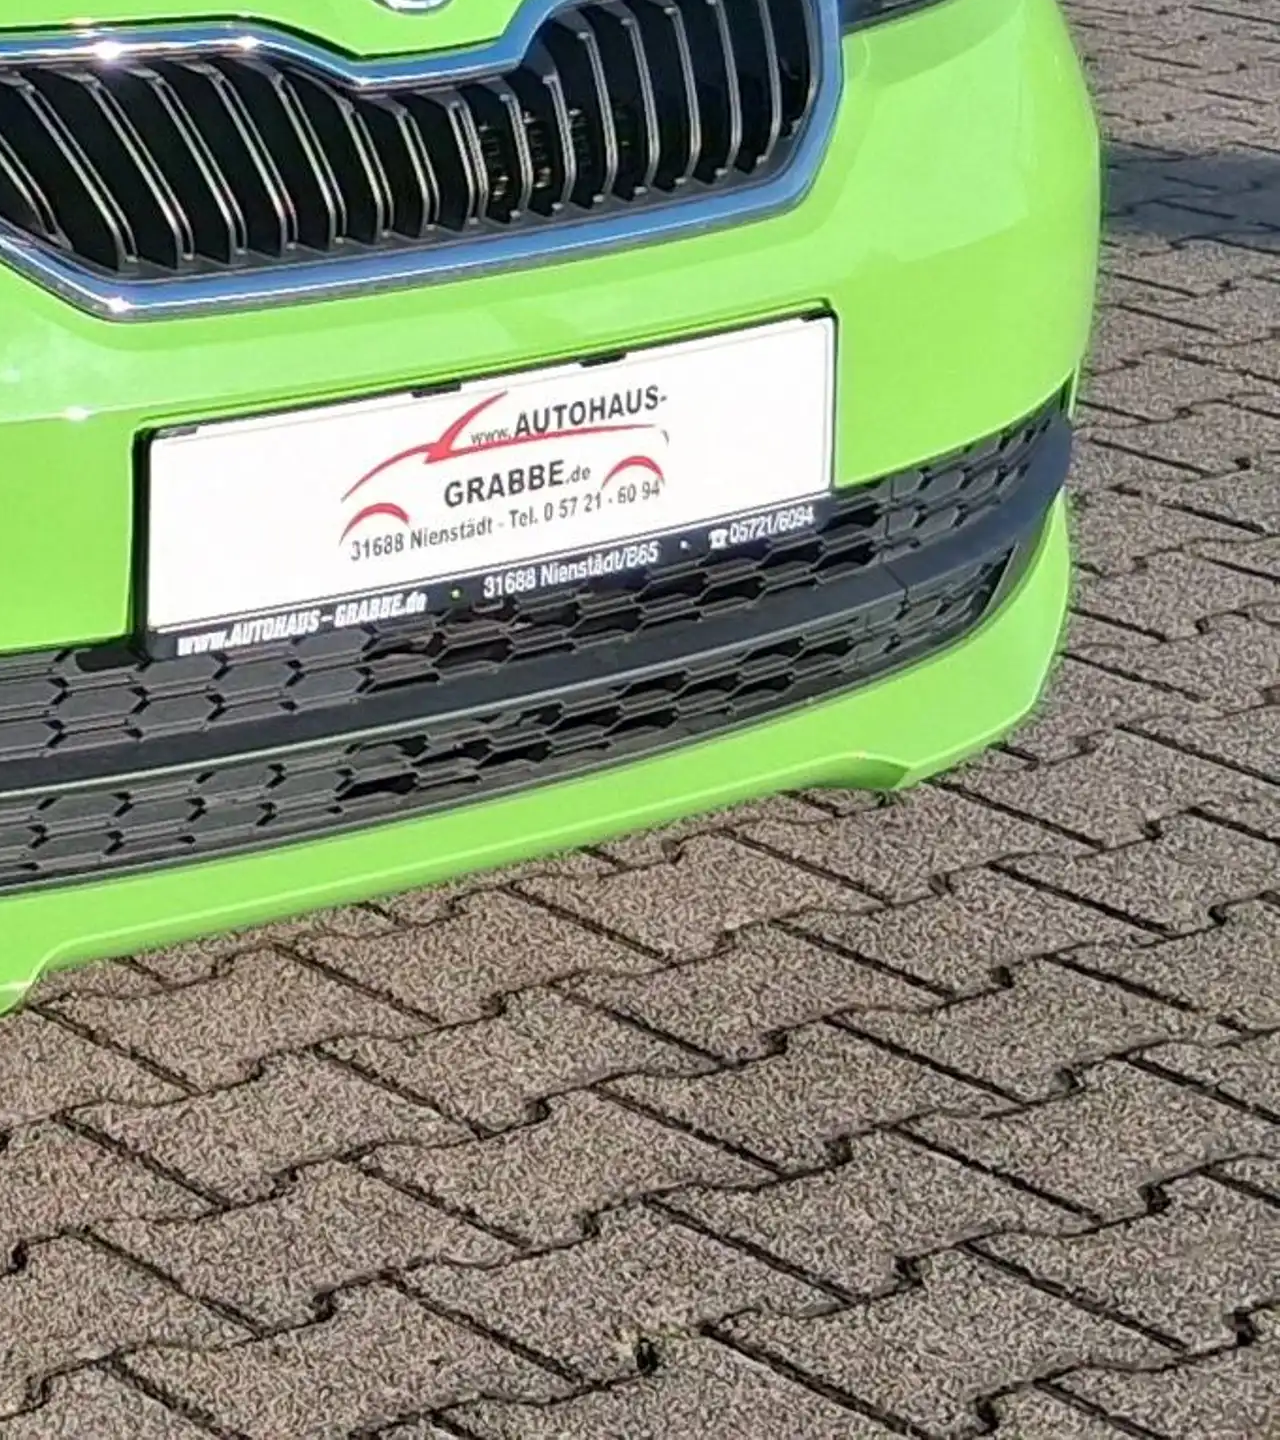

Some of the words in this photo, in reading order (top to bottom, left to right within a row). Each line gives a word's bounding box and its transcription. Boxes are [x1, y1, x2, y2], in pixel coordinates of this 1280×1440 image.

[350, 532, 405, 562] 31688
[410, 516, 493, 550] Nienstädt
[509, 509, 539, 530] Tel.
[558, 497, 578, 519] 57
[584, 492, 602, 513] 21
[641, 479, 661, 499] 94
[444, 460, 592, 508] GRABBE.de
[483, 566, 536, 599] 31688
[540, 541, 659, 588] Nienstädt/B65
[729, 506, 815, 544] 05721/6094
